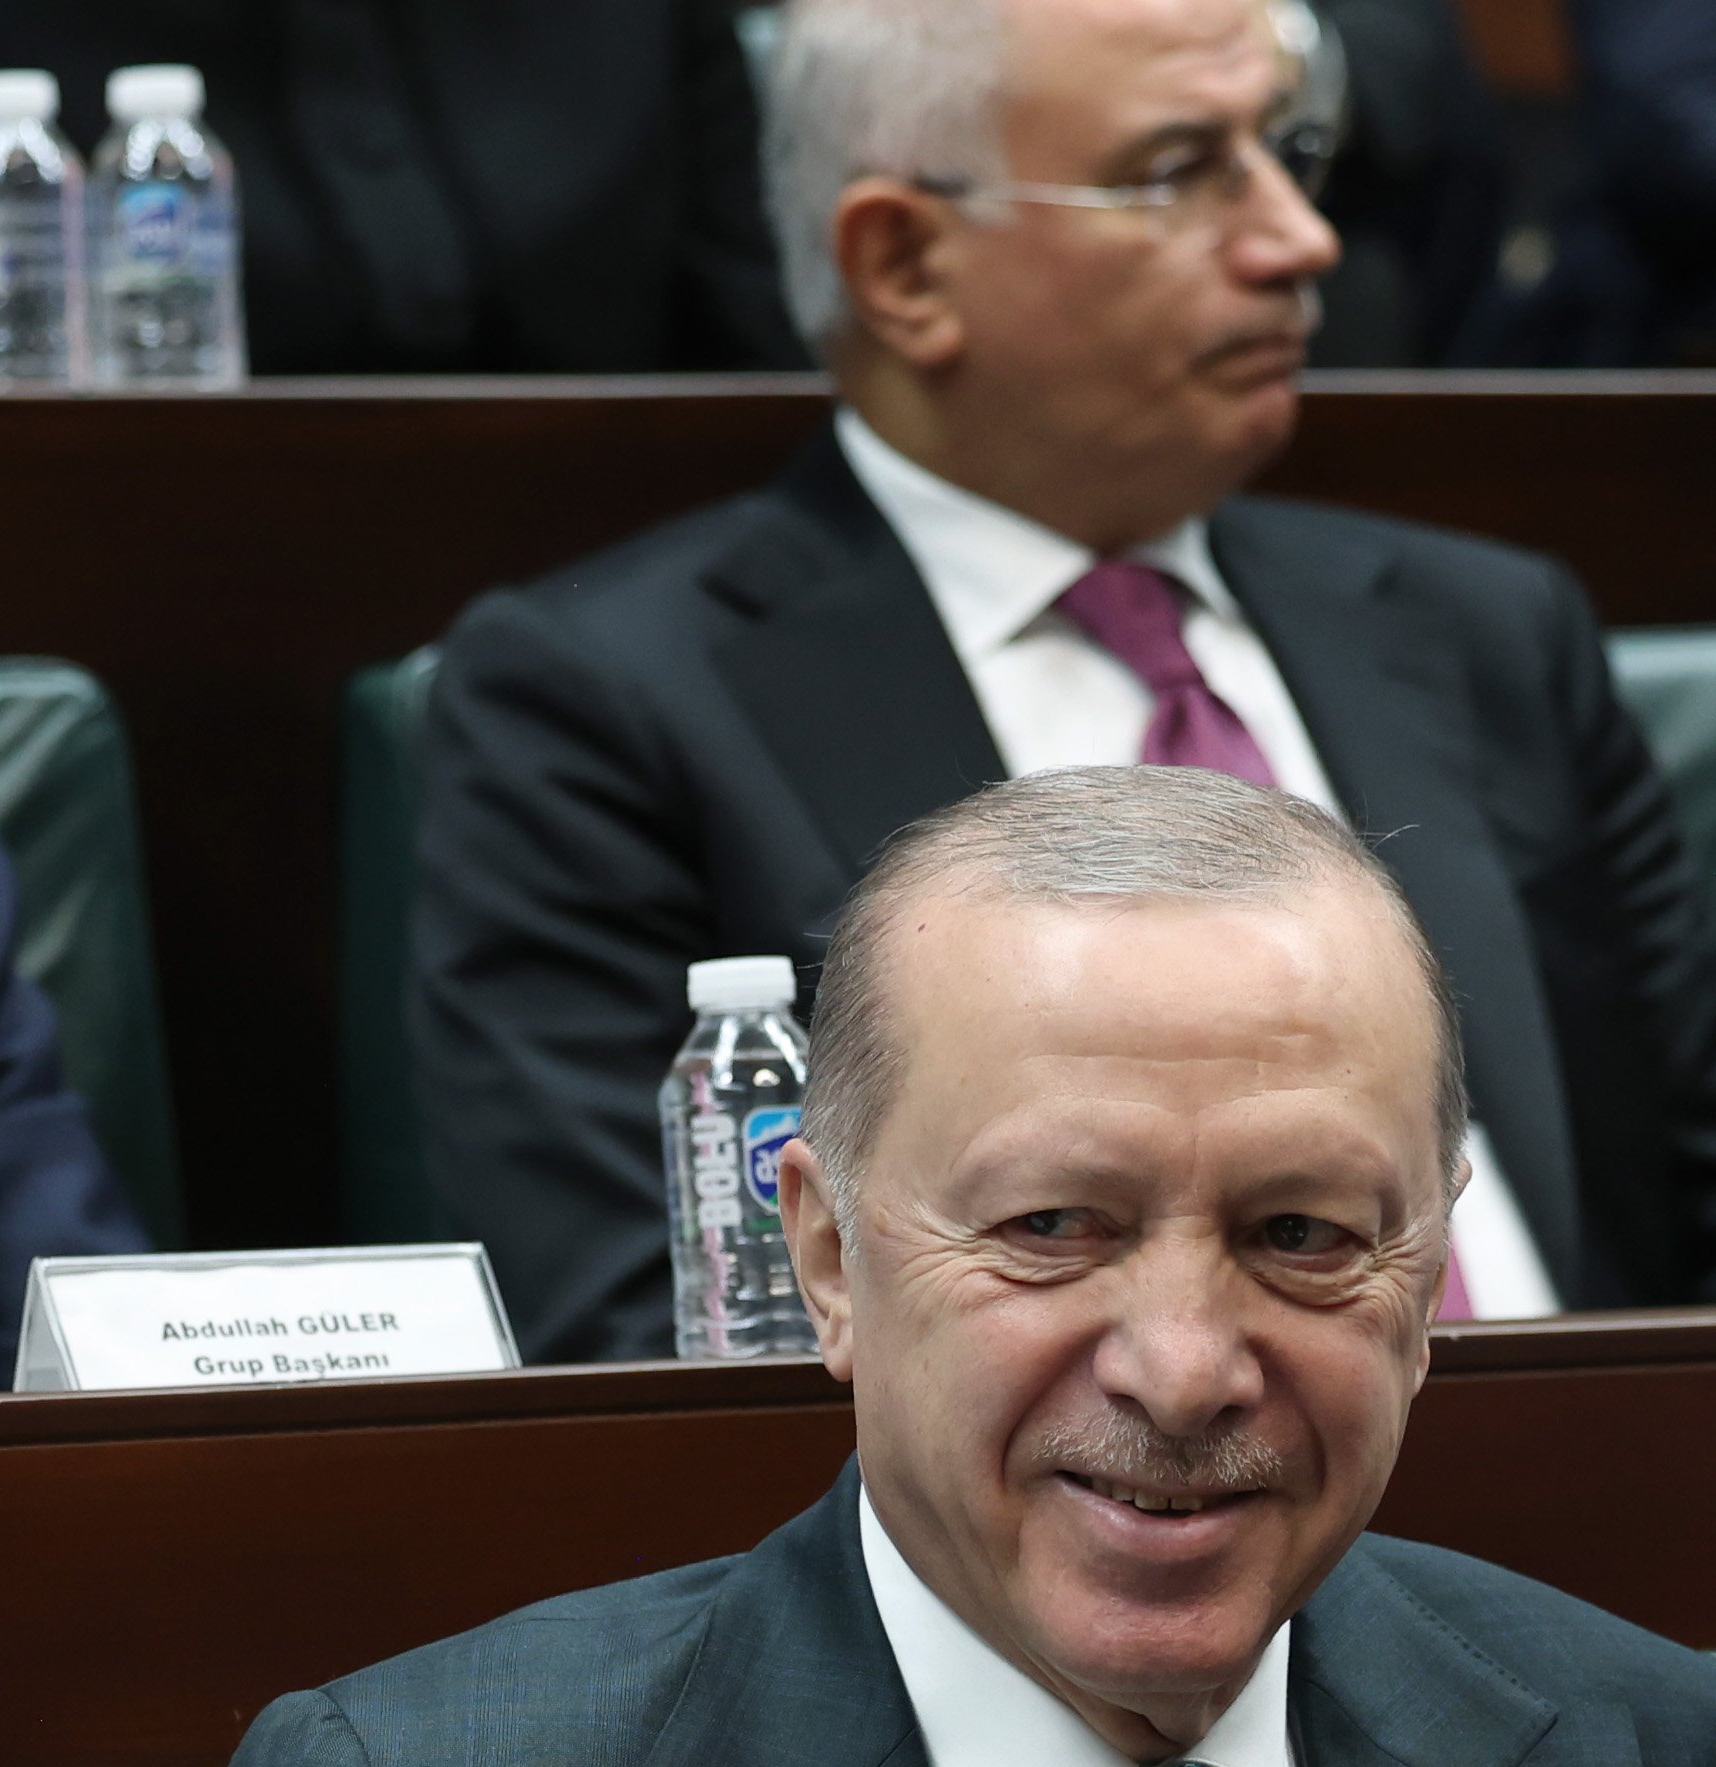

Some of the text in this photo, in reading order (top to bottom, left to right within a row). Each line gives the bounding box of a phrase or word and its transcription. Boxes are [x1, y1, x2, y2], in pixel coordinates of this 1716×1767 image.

[162, 1311, 399, 1342] Abdullah GÜLER
[194, 1350, 390, 1379] Grup Başkanı
